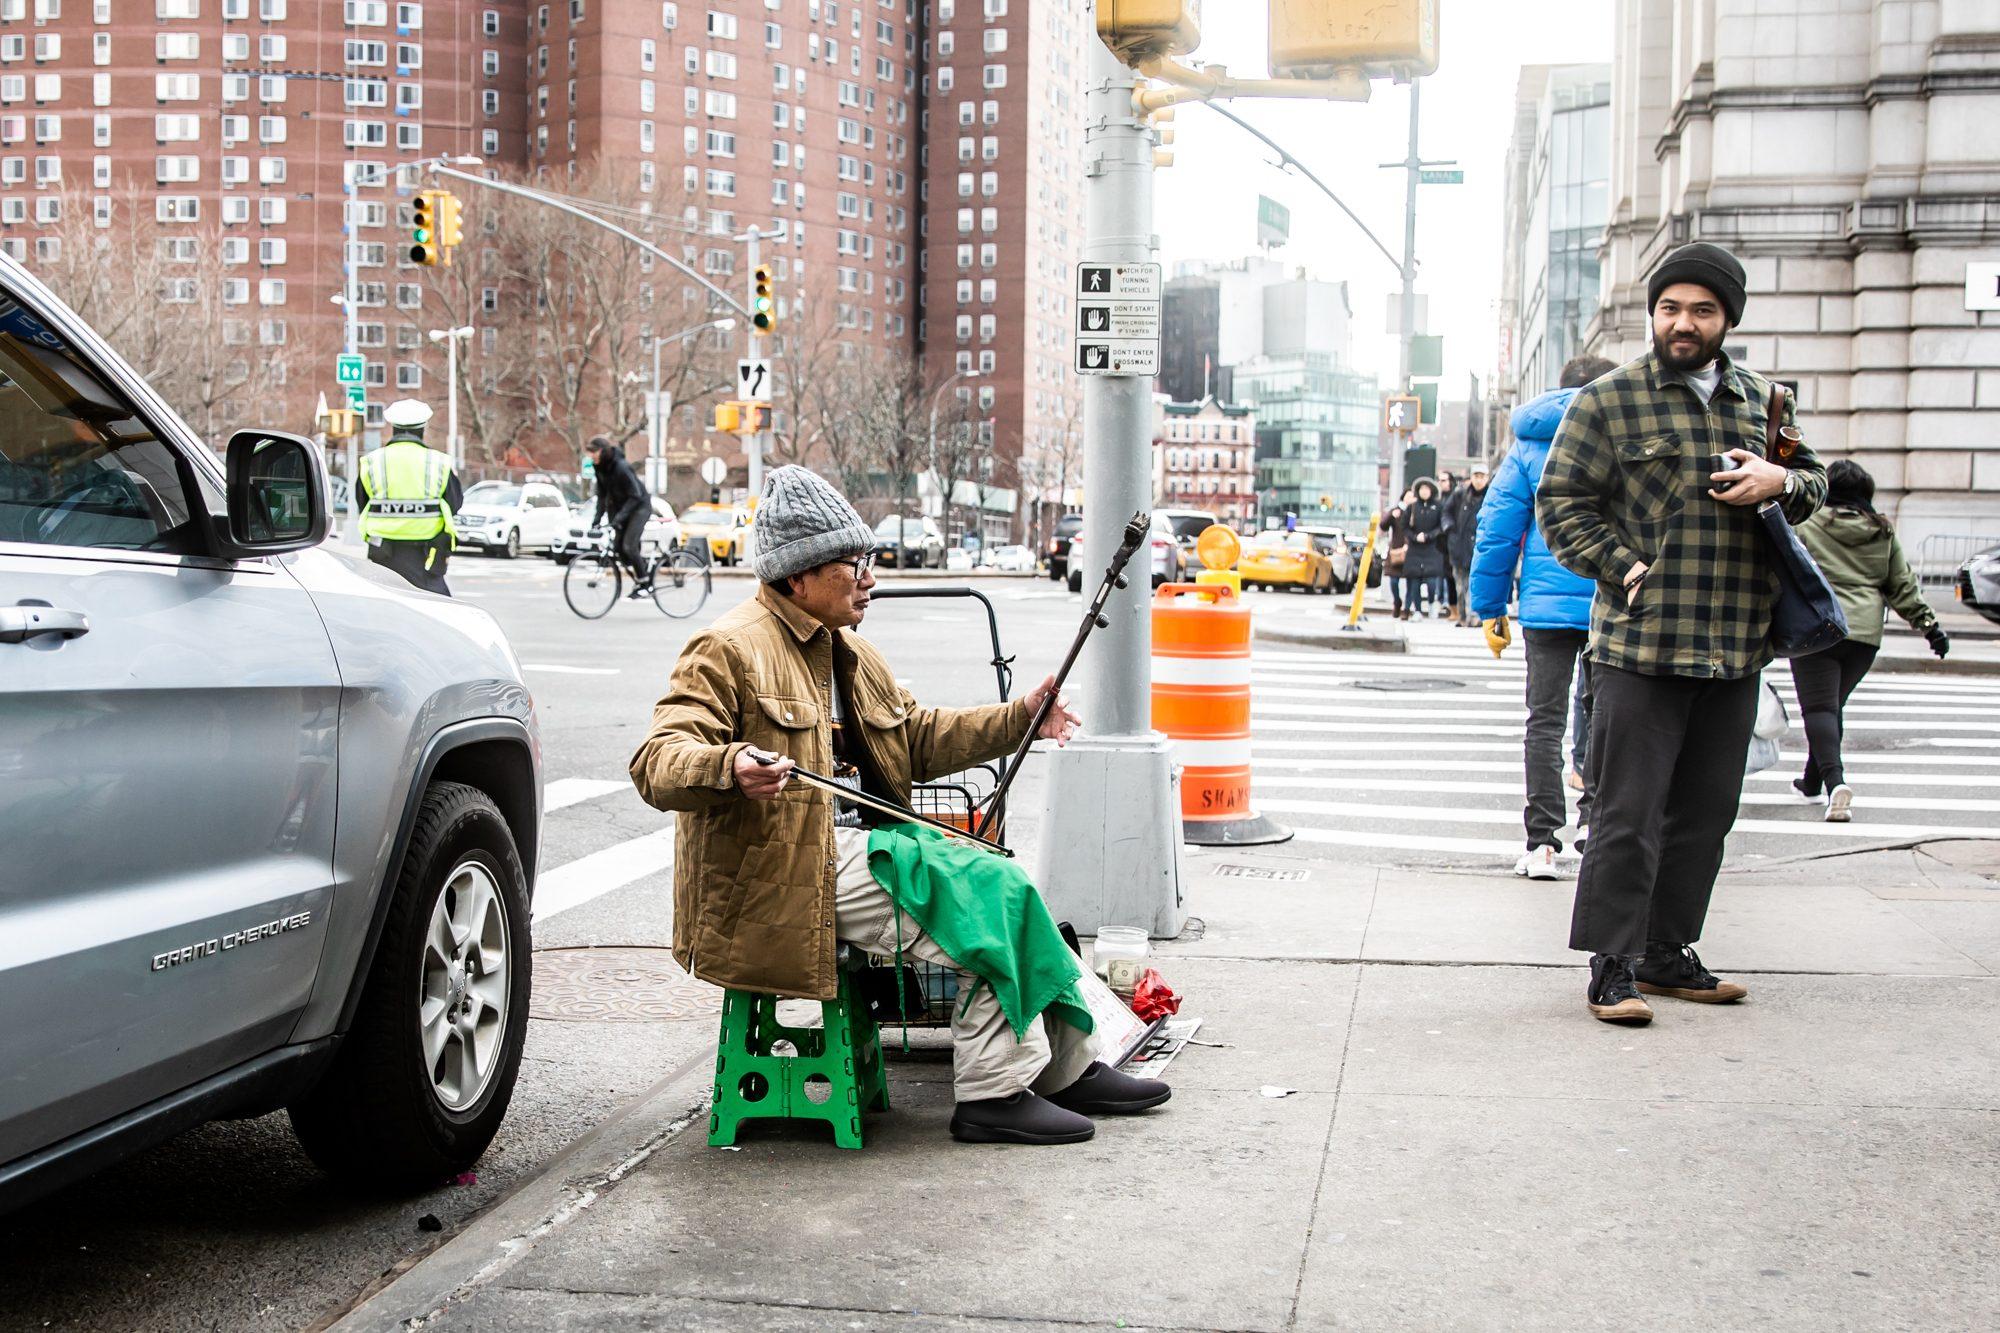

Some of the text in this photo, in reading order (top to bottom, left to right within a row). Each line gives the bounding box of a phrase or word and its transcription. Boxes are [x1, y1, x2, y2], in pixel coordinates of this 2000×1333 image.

[380, 503, 426, 513] NYPD
[152, 910, 311, 971] GRAND CHEROKEE
